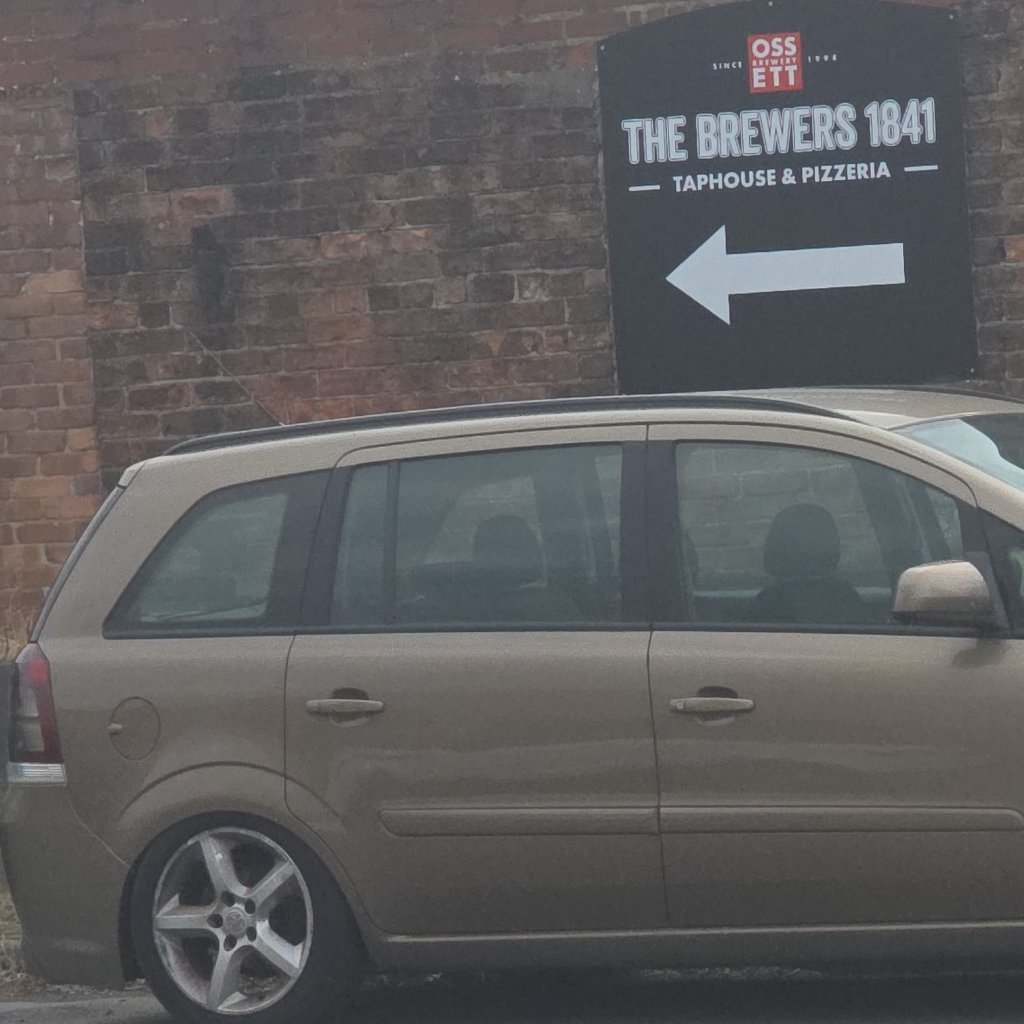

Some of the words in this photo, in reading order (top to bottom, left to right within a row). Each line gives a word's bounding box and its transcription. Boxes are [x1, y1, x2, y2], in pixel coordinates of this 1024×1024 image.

[752, 36, 797, 58] OSS
[712, 61, 743, 70] SINCE
[752, 57, 797, 67] BREWERY
[752, 65, 798, 88] ETT
[621, 115, 689, 164] THE
[696, 103, 857, 160] BREWERS
[863, 97, 936, 147] 1841
[673, 169, 776, 192] TAPHOUSE
[781, 168, 797, 185] &
[802, 161, 891, 183] PIZZERIA
